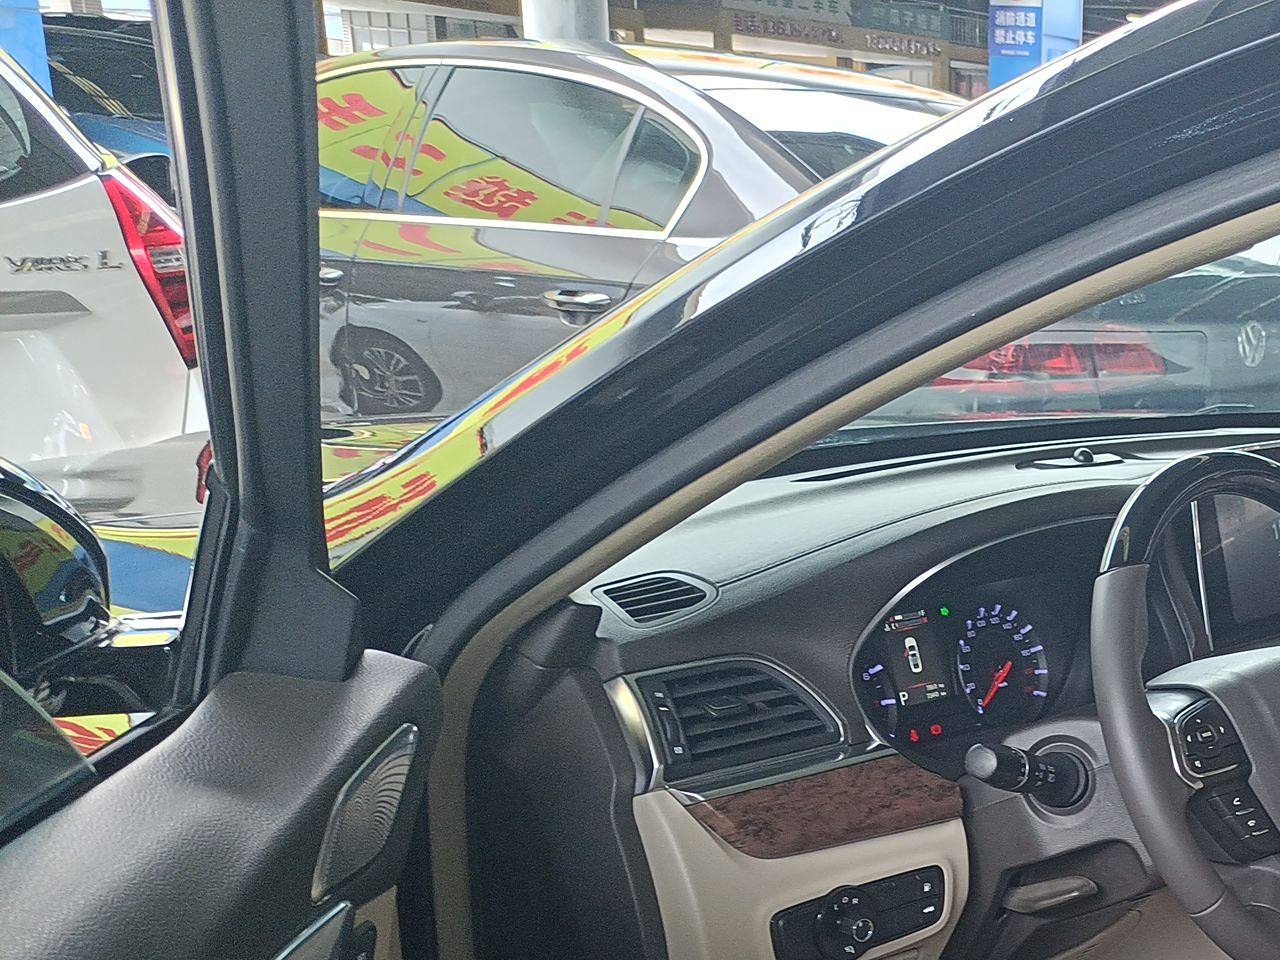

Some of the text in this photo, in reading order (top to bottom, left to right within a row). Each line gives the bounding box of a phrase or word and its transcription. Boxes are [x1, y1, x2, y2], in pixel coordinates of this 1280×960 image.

[995, 10, 1036, 27] 消防通道
[994, 29, 1036, 46] 禁止停车
[898, 691, 909, 706] P
